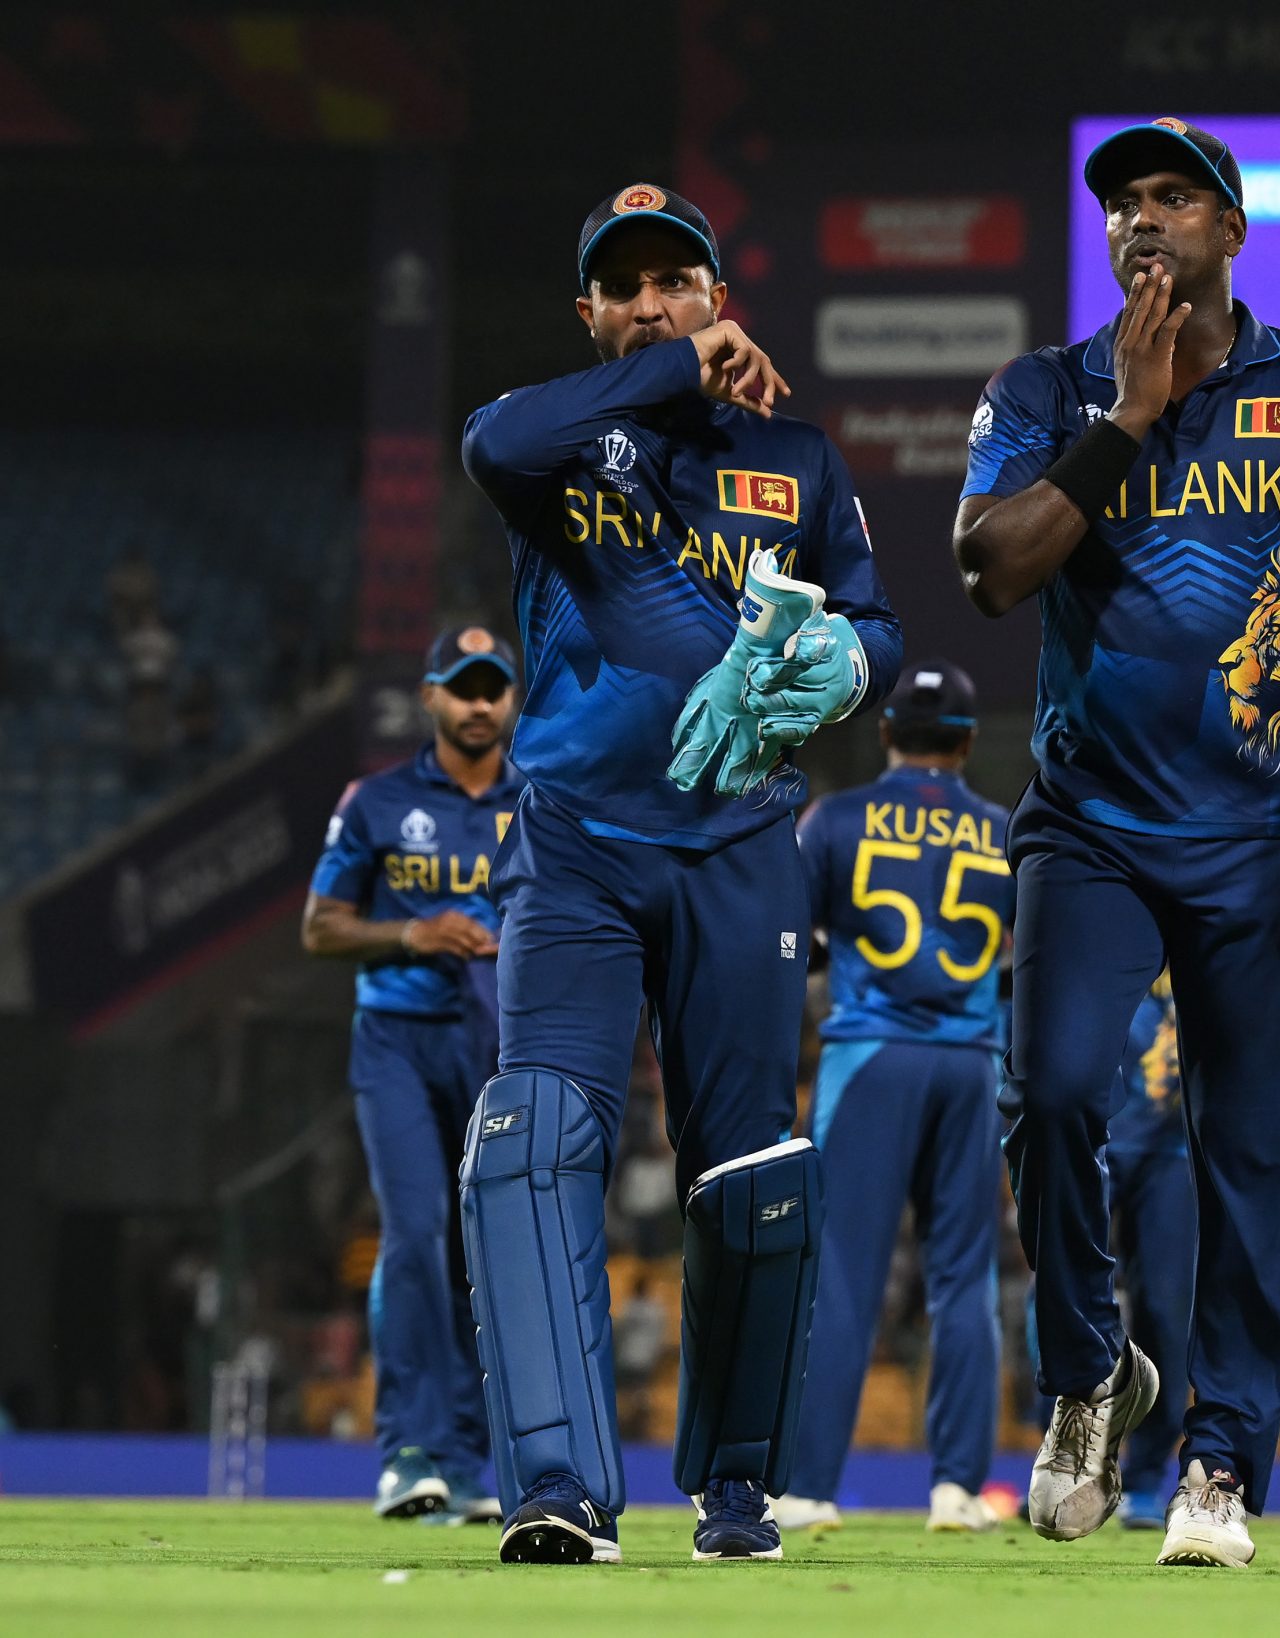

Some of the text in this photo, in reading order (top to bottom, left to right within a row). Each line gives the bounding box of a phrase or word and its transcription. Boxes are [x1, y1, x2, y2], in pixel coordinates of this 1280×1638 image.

[865, 801, 1004, 857] KUSAL
[384, 853, 440, 894] SRI
[851, 838, 1012, 982] 55
[483, 1112, 523, 1135] SF
[759, 1198, 799, 1223] SF
